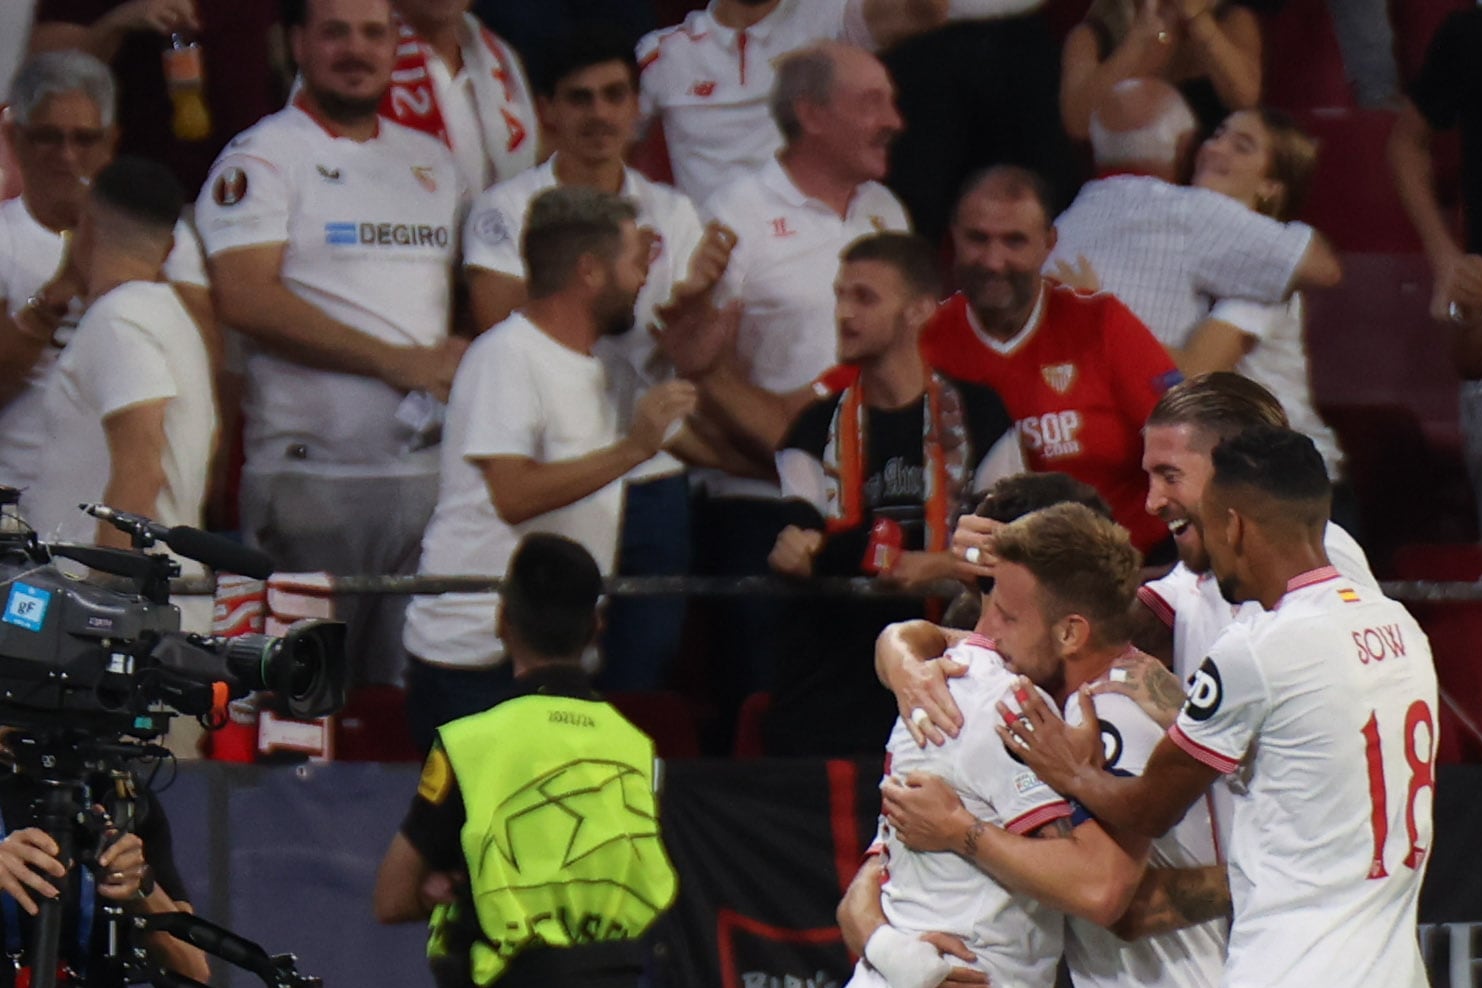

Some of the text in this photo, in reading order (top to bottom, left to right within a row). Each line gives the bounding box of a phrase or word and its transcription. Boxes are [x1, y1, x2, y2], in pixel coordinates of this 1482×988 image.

[359, 222, 449, 248] DEGIRO
[1352, 623, 1407, 665] SOW
[1360, 699, 1435, 881] 18
